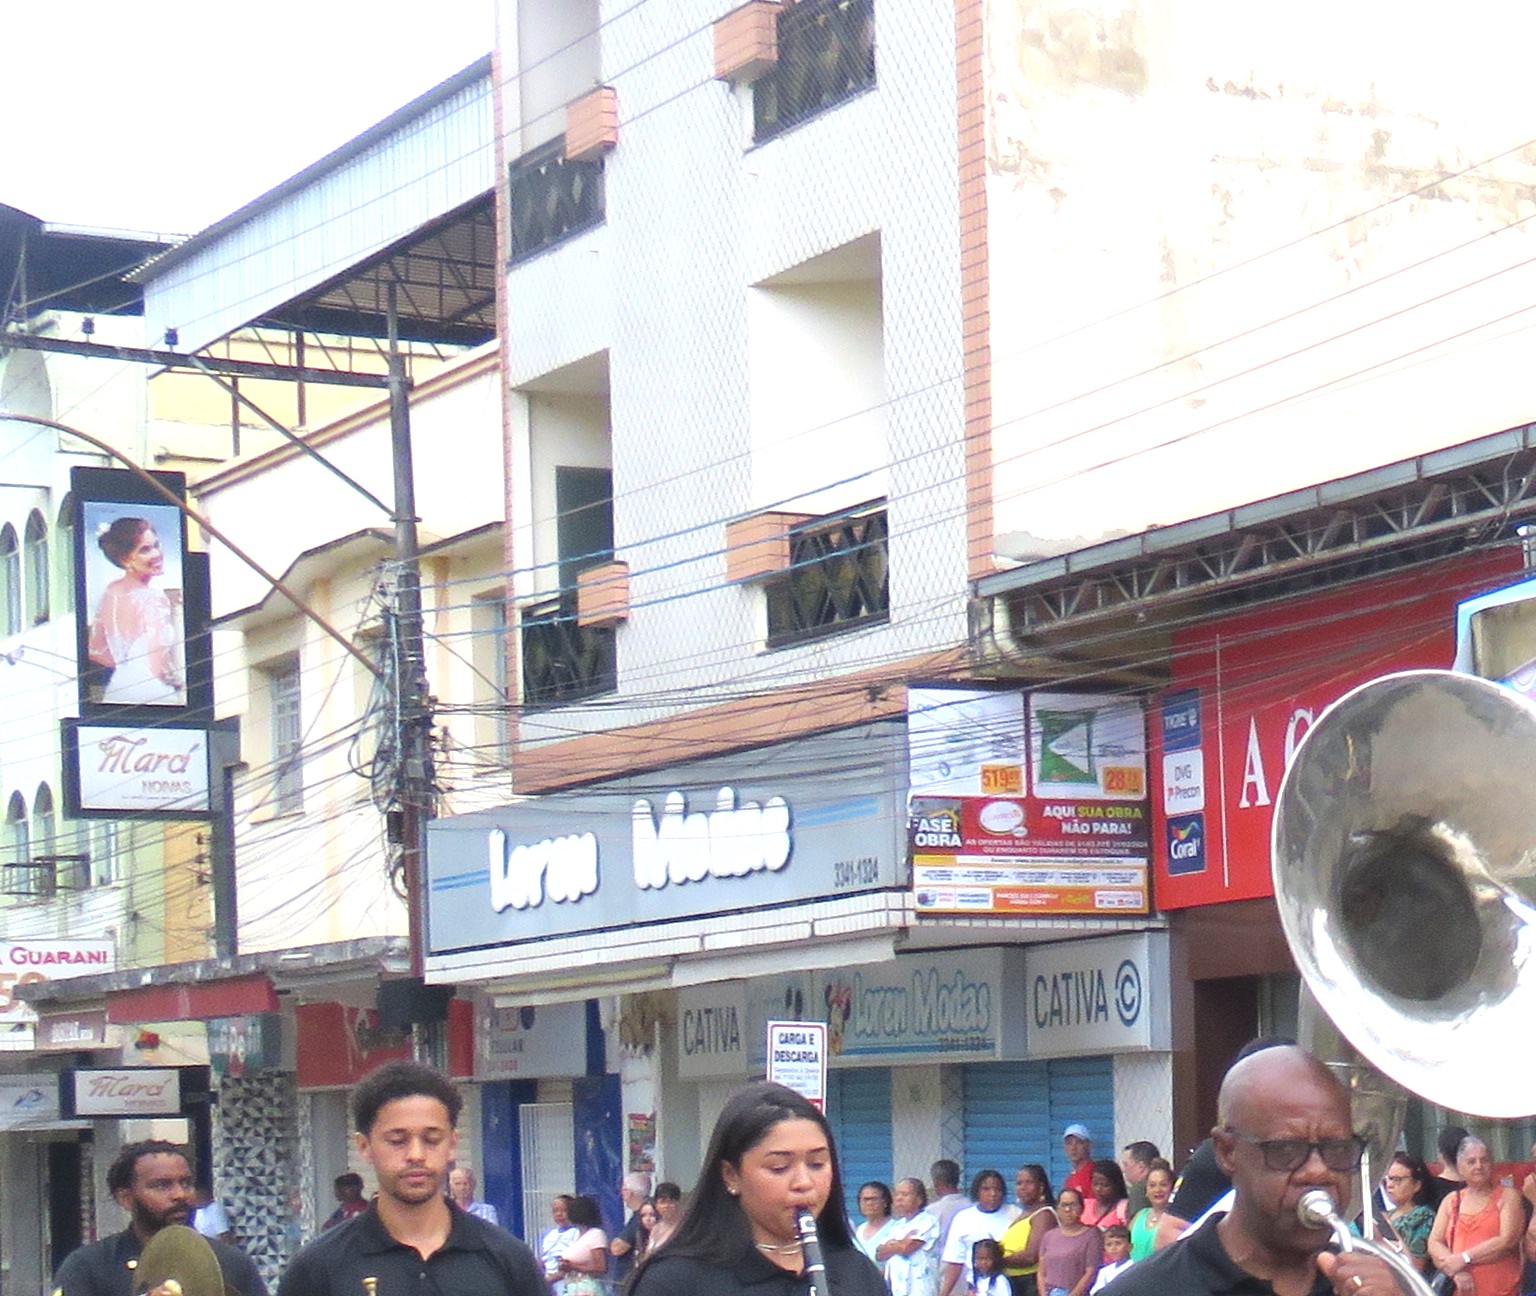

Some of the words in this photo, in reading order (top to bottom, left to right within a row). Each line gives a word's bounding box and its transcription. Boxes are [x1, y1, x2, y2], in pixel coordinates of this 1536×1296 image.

[1043, 805, 1076, 819] AQUI
[1078, 806, 1106, 818] SUA
[1107, 806, 1143, 819] OBRA
[631, 785, 792, 889] Modas
[1061, 821, 1090, 835] NÃO
[1092, 822, 1132, 835] PARA!
[915, 833, 962, 848] OBRA
[1170, 837, 1198, 860] Coral
[489, 828, 599, 913] Loren
[10, 946, 108, 965] GUARANI
[853, 969, 906, 1039] Loren
[911, 966, 992, 1036] Modas
[1033, 968, 1109, 1030] CATIVA
[683, 1005, 741, 1058] CATIVA
[778, 1032, 808, 1045] CARGA
[809, 1033, 815, 1045] E
[774, 1050, 820, 1064] DESCARGA
